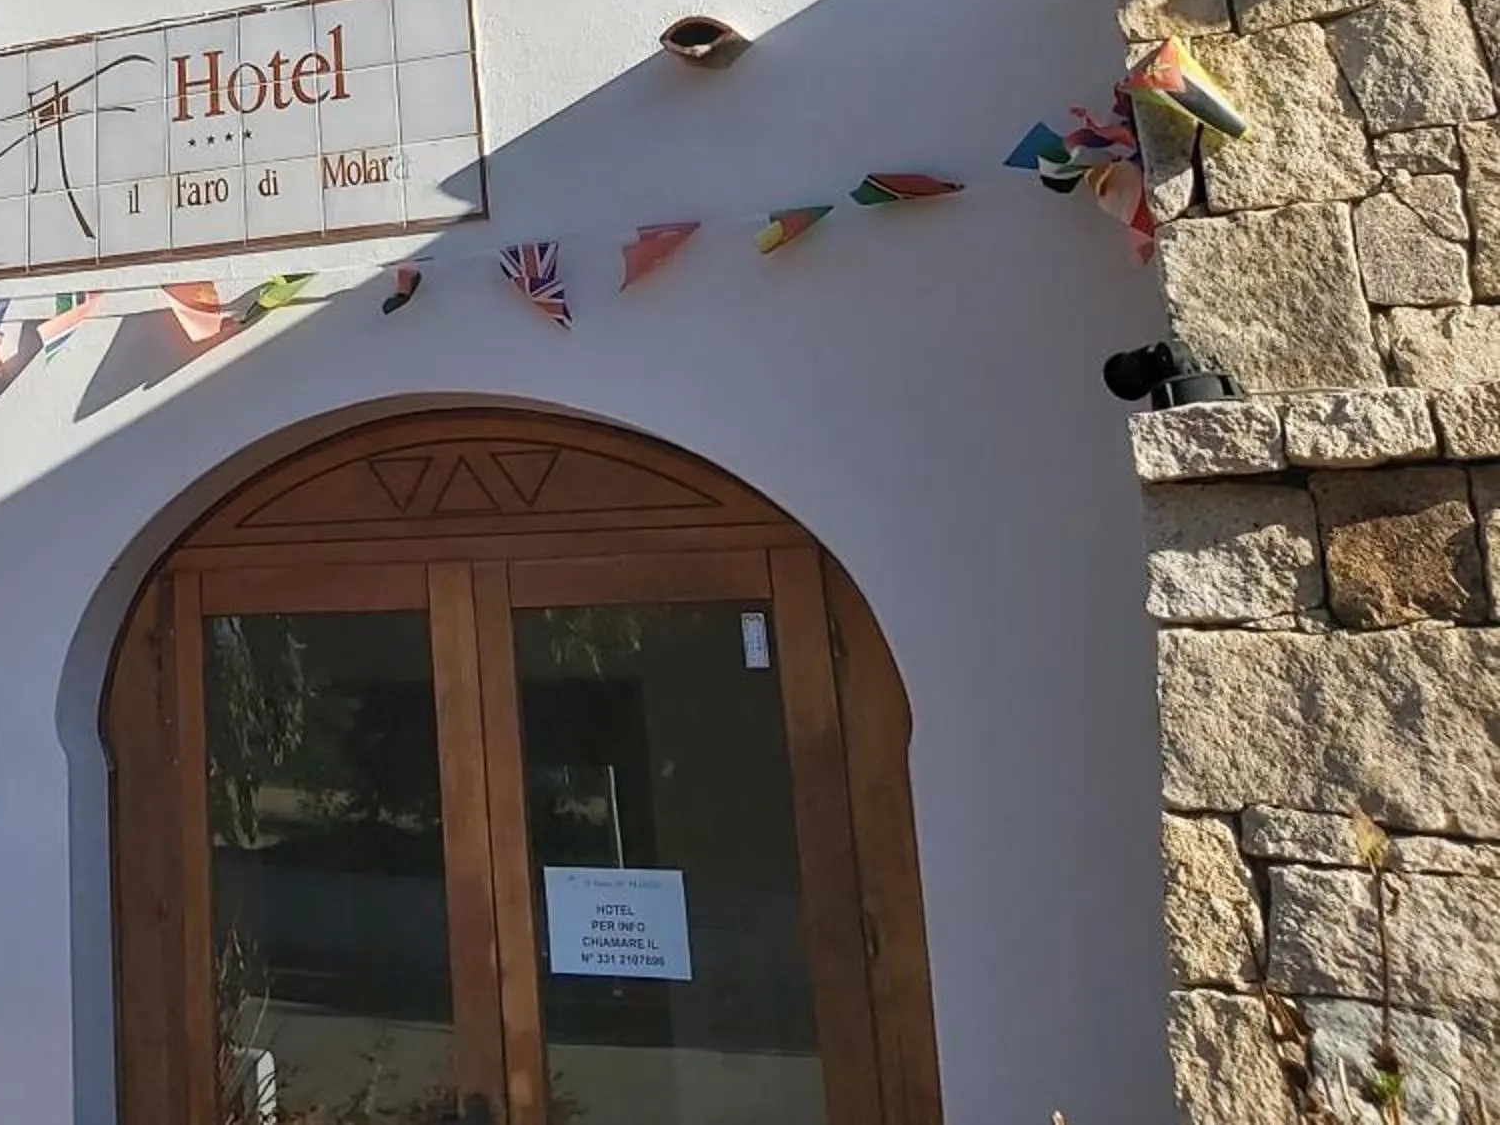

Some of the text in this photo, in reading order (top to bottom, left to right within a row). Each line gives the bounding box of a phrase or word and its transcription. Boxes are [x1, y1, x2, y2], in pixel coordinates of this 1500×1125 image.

[171, 24, 351, 122] Hotel
[128, 183, 141, 215] il
[175, 176, 229, 209] Faro
[257, 169, 280, 197] di
[596, 904, 635, 916] HOTEL
[591, 920, 645, 933] PER INFO
[581, 936, 660, 950] CHIAMARE IL
